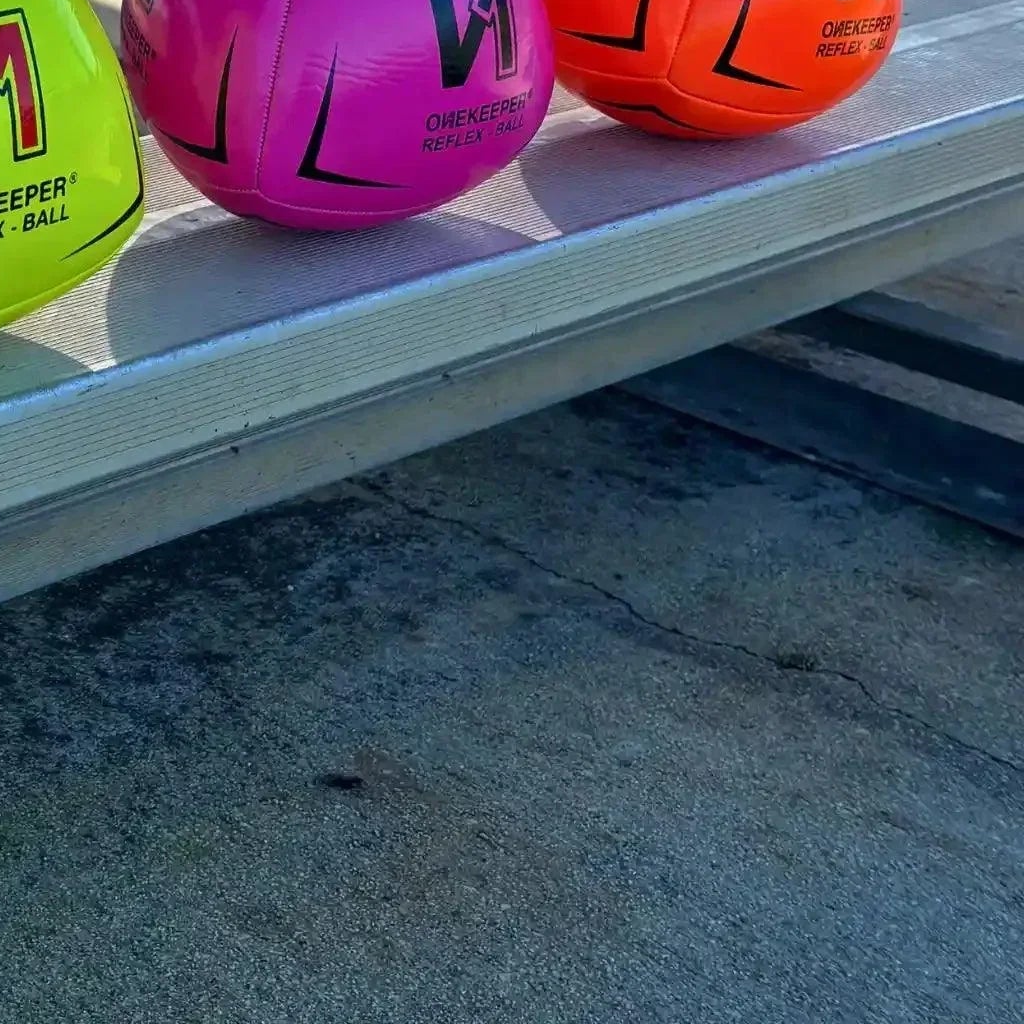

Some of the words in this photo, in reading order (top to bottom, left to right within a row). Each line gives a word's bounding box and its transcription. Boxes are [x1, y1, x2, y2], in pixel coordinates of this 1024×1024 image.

[816, 41, 864, 58] REFLEX
[422, 129, 483, 152] REFLEX
[495, 116, 524, 136] BALL
[22, 204, 69, 233] BALL
